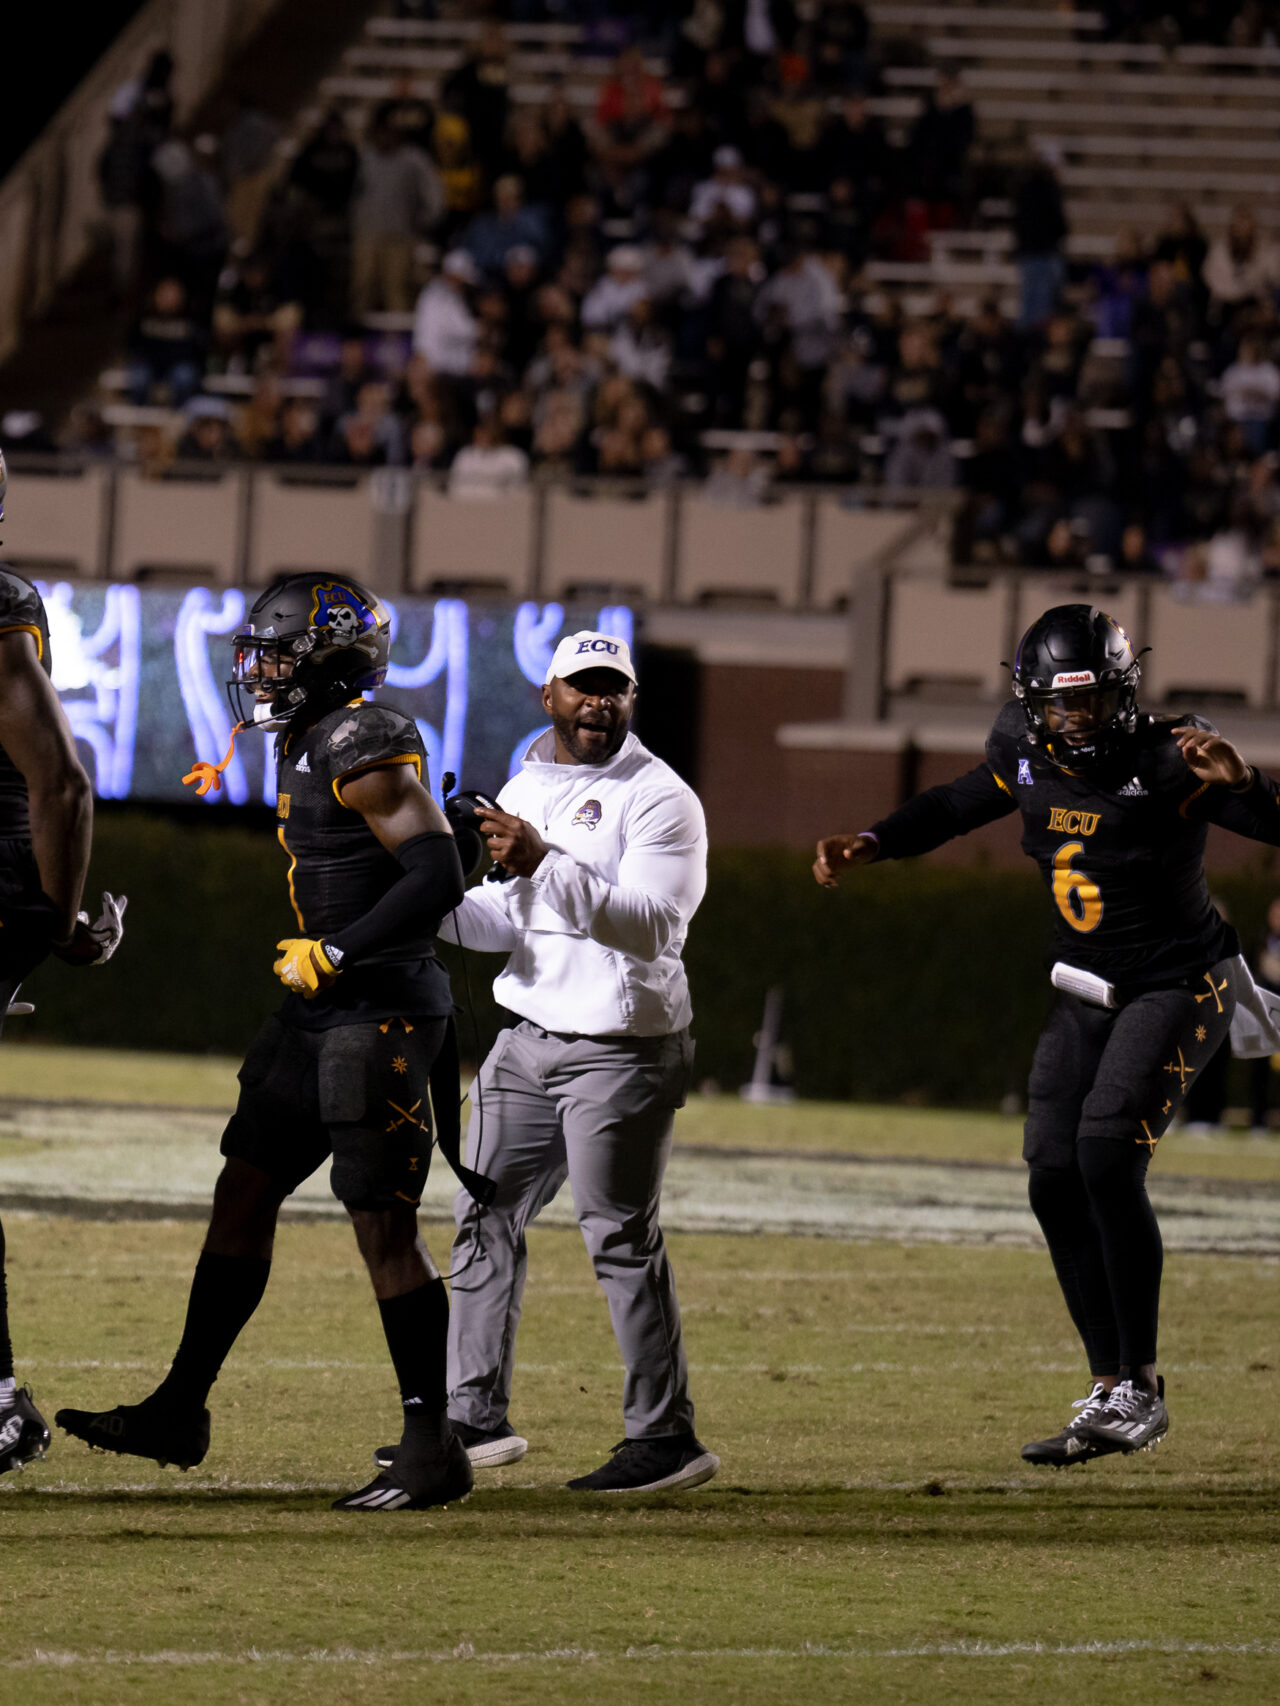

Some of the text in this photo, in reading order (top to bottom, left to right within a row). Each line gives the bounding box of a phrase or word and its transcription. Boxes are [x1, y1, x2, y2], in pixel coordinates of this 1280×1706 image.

[323, 591, 346, 604] ECU
[575, 639, 620, 656] ECU
[1057, 673, 1091, 684] Riddell
[1046, 807, 1103, 837] ECU
[1051, 840, 1104, 935] 6
